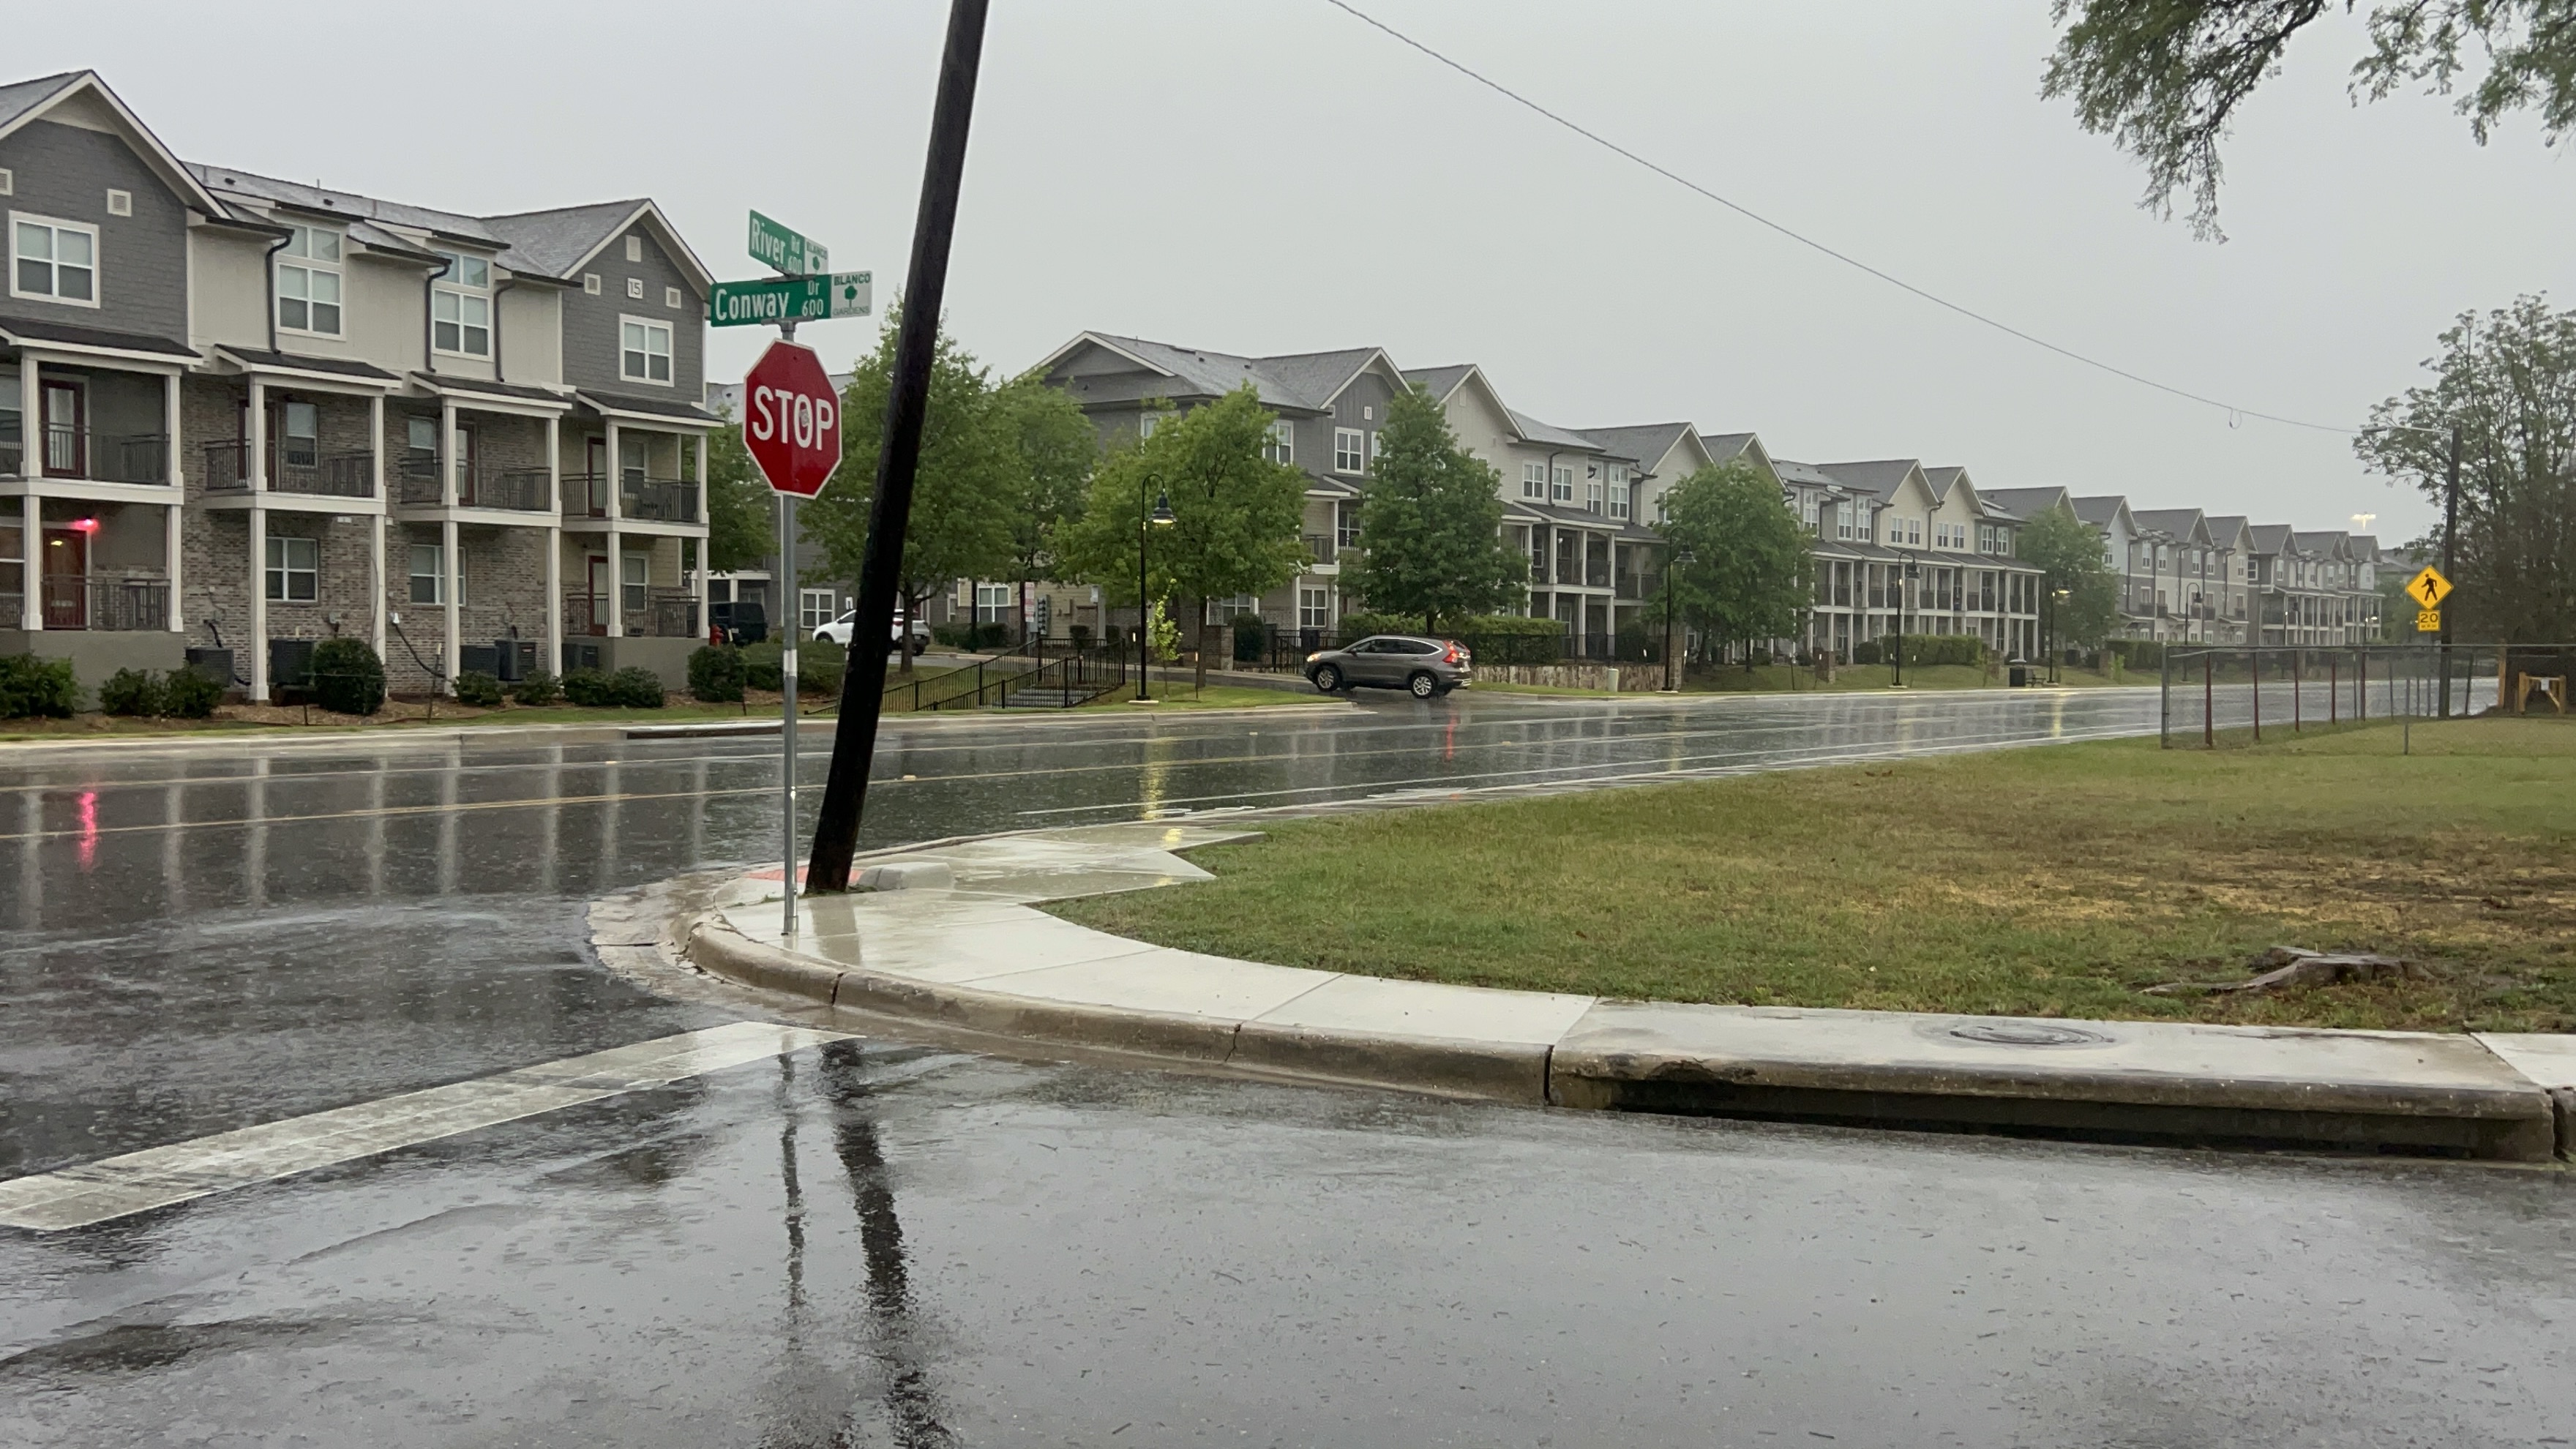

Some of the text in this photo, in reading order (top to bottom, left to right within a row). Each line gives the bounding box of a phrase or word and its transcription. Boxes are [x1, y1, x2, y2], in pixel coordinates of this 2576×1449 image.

[752, 218, 801, 264] River Rd
[806, 242, 828, 261] BLANCO
[788, 255, 803, 275] 600
[629, 281, 642, 296] 15
[834, 273, 871, 286] BLANCO
[716, 280, 820, 321] Conway Dr
[801, 299, 824, 317] 600
[832, 305, 870, 316] GARDENS
[752, 385, 834, 452] STOP
[2420, 613, 2438, 623] 20
